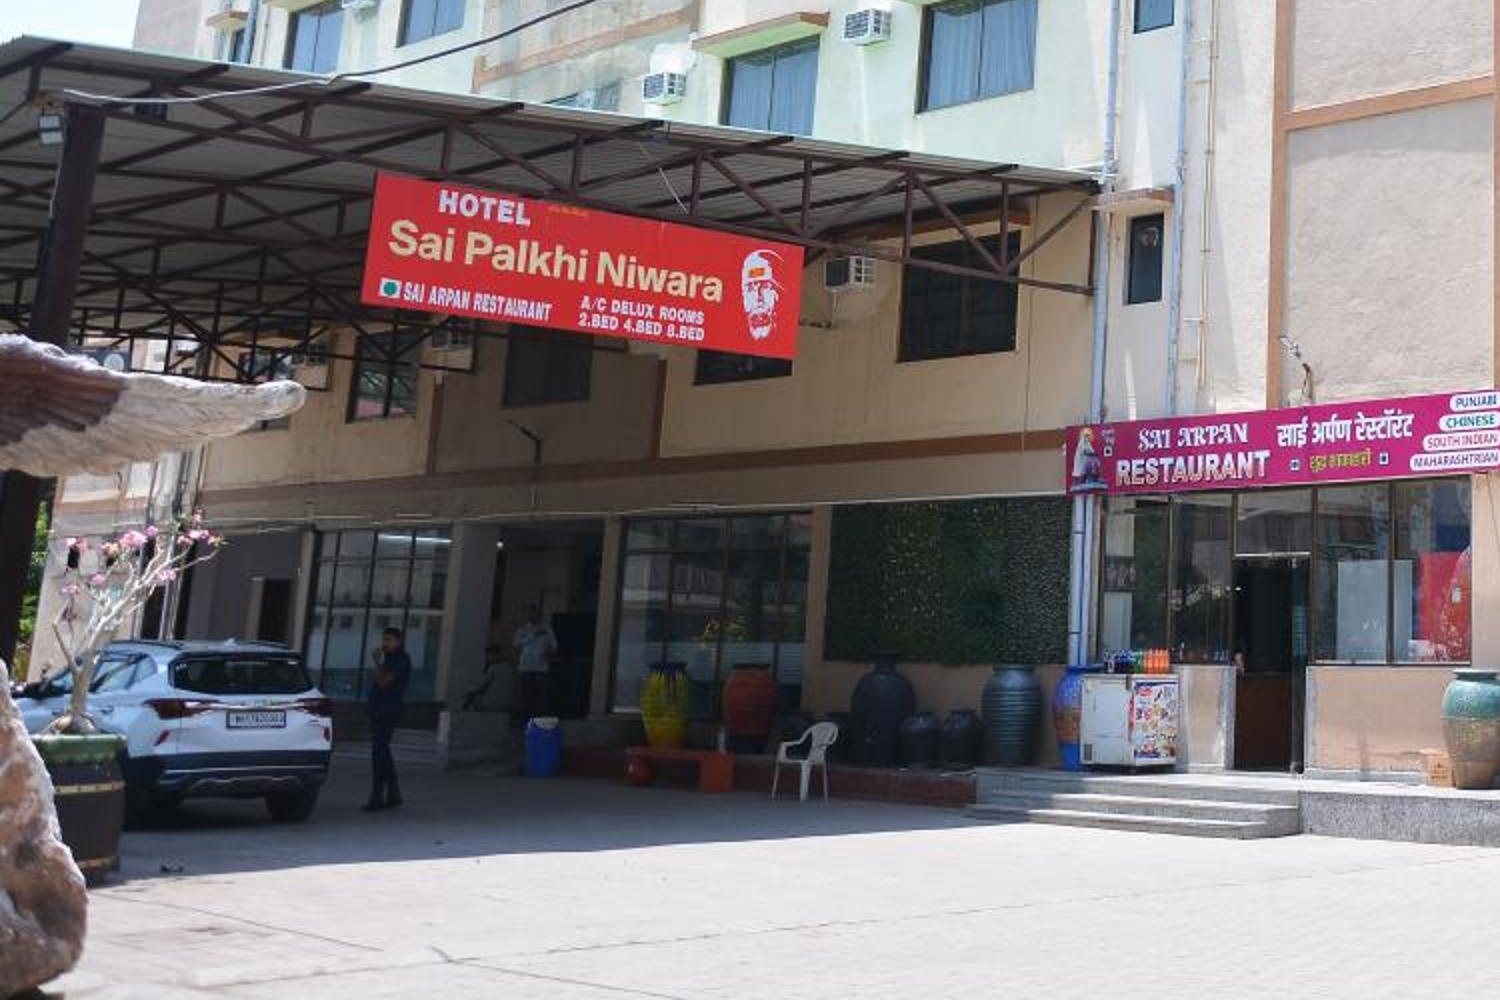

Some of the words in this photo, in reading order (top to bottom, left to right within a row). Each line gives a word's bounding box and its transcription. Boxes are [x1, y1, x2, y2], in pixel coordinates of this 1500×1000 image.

[438, 189, 531, 227] HOTEL
[388, 219, 456, 263] Sai
[464, 231, 589, 282] Palkhi
[596, 251, 724, 303] Niwara
[403, 281, 425, 303] SAI
[428, 286, 471, 310] ARPAN
[473, 292, 553, 322] RESTAURANT
[580, 295, 607, 312] A/C
[611, 299, 655, 319] DELUX
[659, 305, 705, 325] ROOMS
[578, 312, 619, 330] 2.BED
[623, 318, 663, 336] 4.BED
[1455, 394, 1498, 409] PUNJABI
[1276, 415, 1309, 448] साई
[1311, 413, 1353, 444] अर्पण
[1445, 414, 1496, 429] CHINESE
[1138, 427, 1171, 453] SAI
[1177, 423, 1249, 448] ARPAN
[1427, 434, 1460, 449] SOUTH
[1461, 433, 1498, 446] INDIAN
[1116, 450, 1271, 487] RESTAURANT
[1413, 451, 1499, 468] MAHARASHTRIAN
